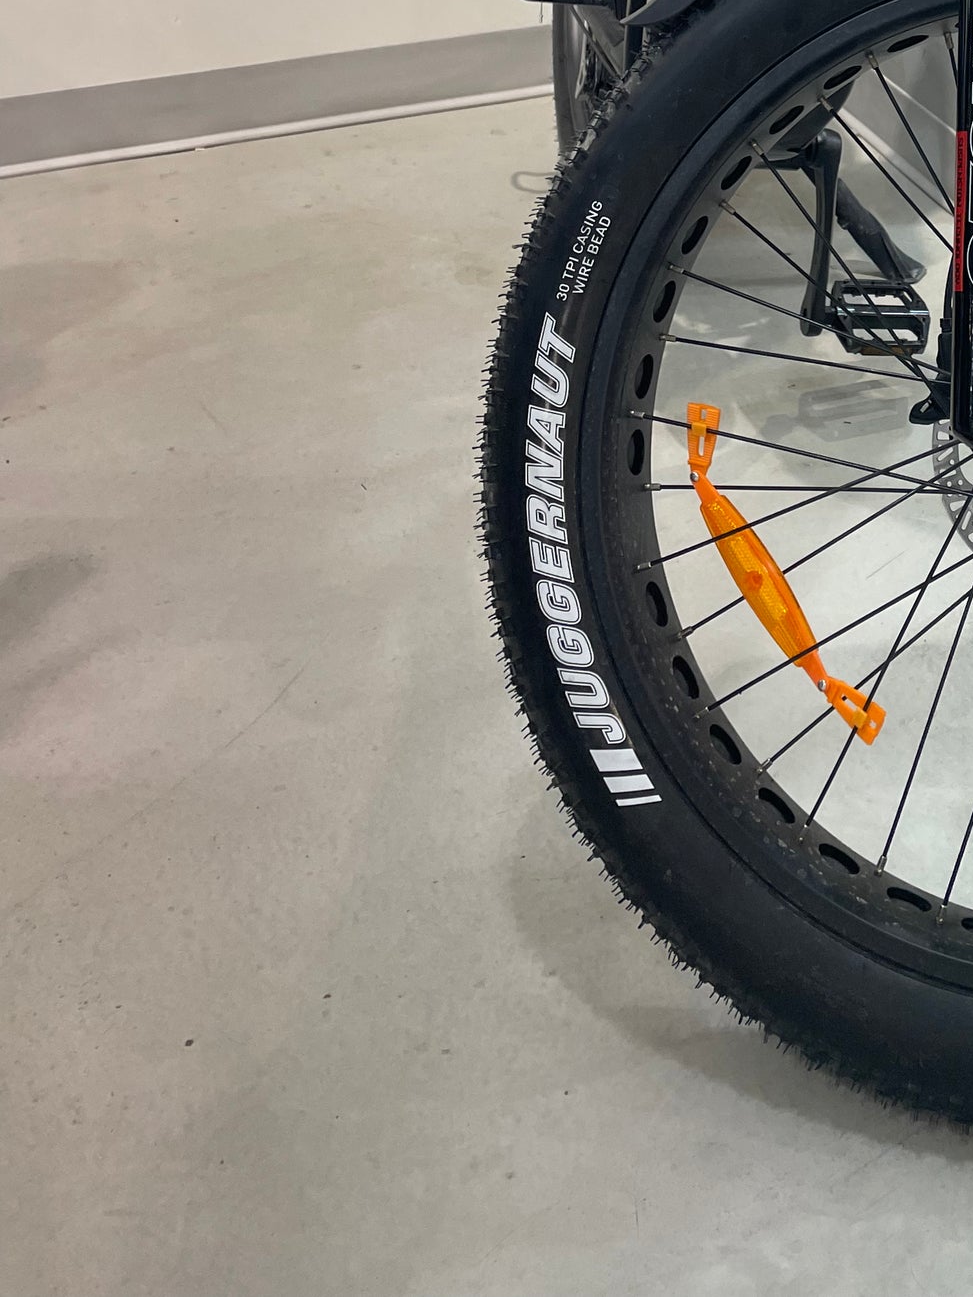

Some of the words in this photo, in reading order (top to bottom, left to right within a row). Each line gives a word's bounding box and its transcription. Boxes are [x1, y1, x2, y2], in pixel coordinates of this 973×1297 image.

[572, 199, 603, 254] CASING
[562, 256, 580, 279] TPI
[572, 256, 595, 294] WIRE
[586, 215, 612, 255] BEAD
[556, 283, 571, 302] 30
[523, 311, 628, 747] JUGGERNAUT
